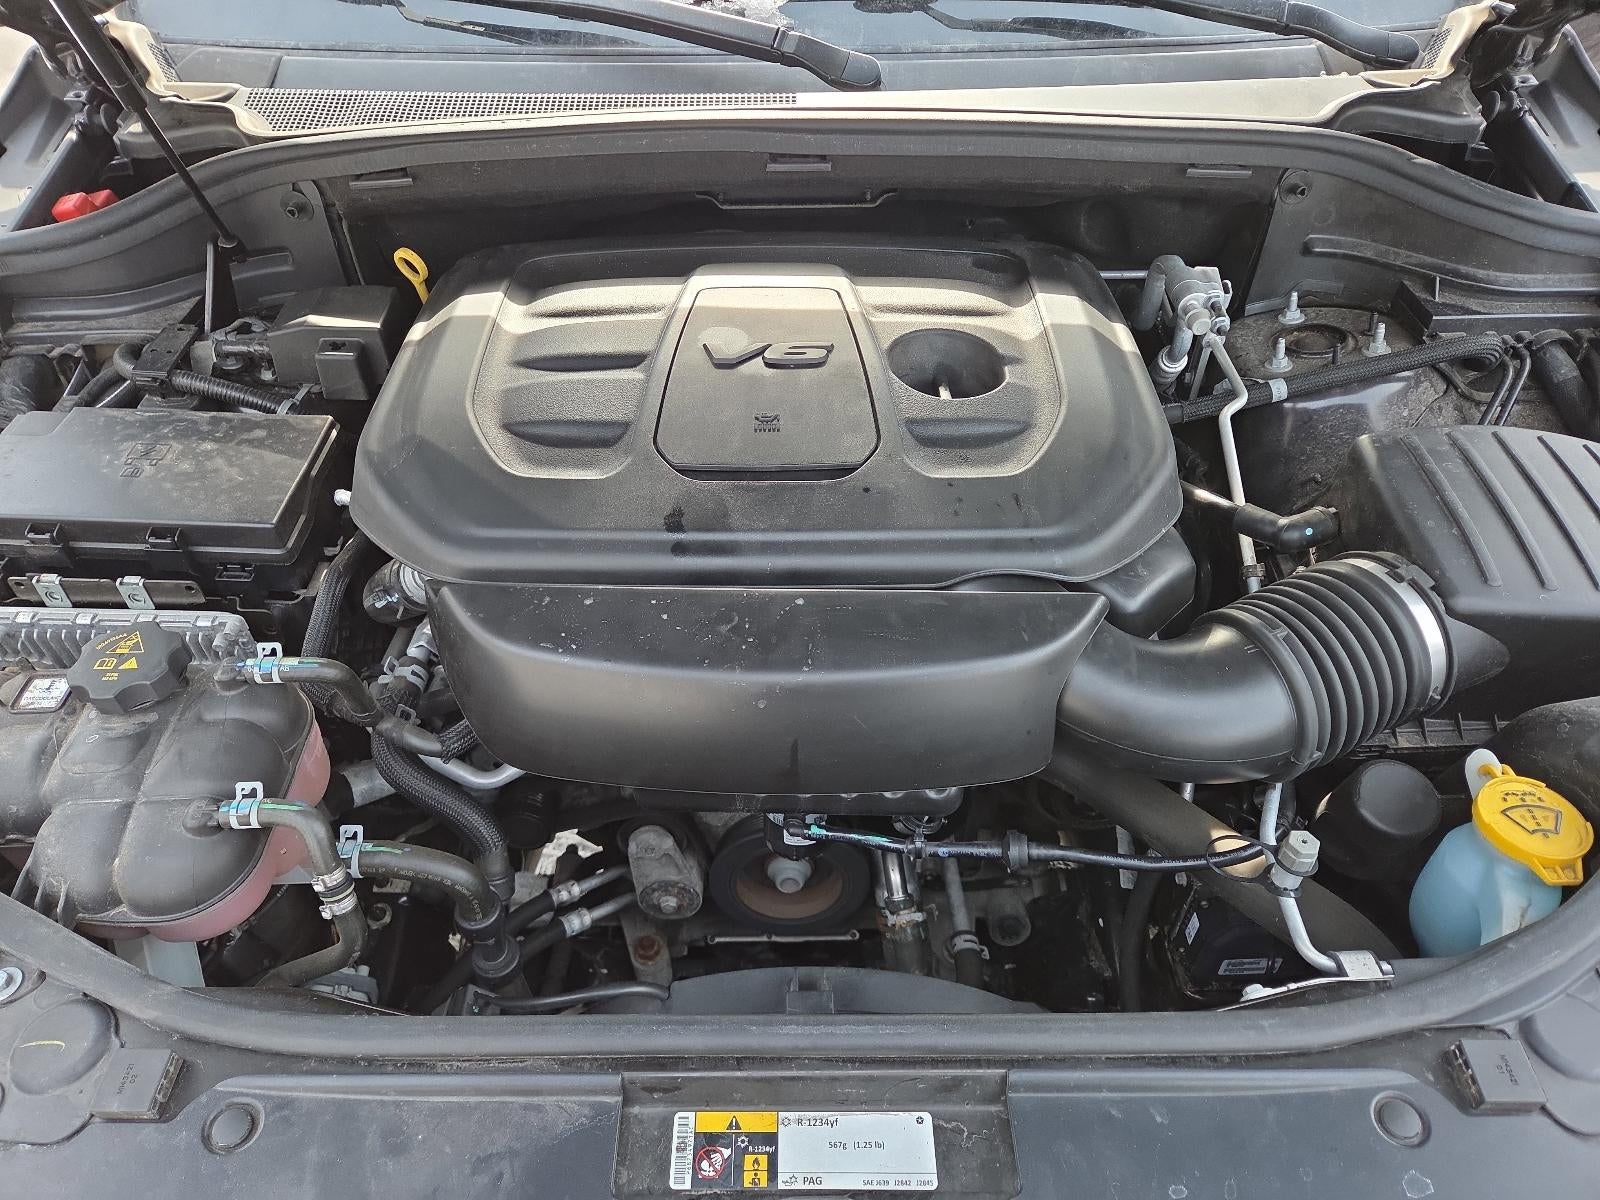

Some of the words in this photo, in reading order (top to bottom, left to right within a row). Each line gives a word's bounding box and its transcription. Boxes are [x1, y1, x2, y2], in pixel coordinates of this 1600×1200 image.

[702, 341, 835, 369] V6
[797, 1118, 839, 1129] R-1234yf
[748, 1145, 776, 1154] R-1234yf
[828, 1141, 848, 1151] 567g
[853, 1141, 873, 1151] (1.25
[874, 1141, 885, 1151] lb)
[803, 1176, 823, 1186] PAG
[862, 1179, 875, 1187] SAE
